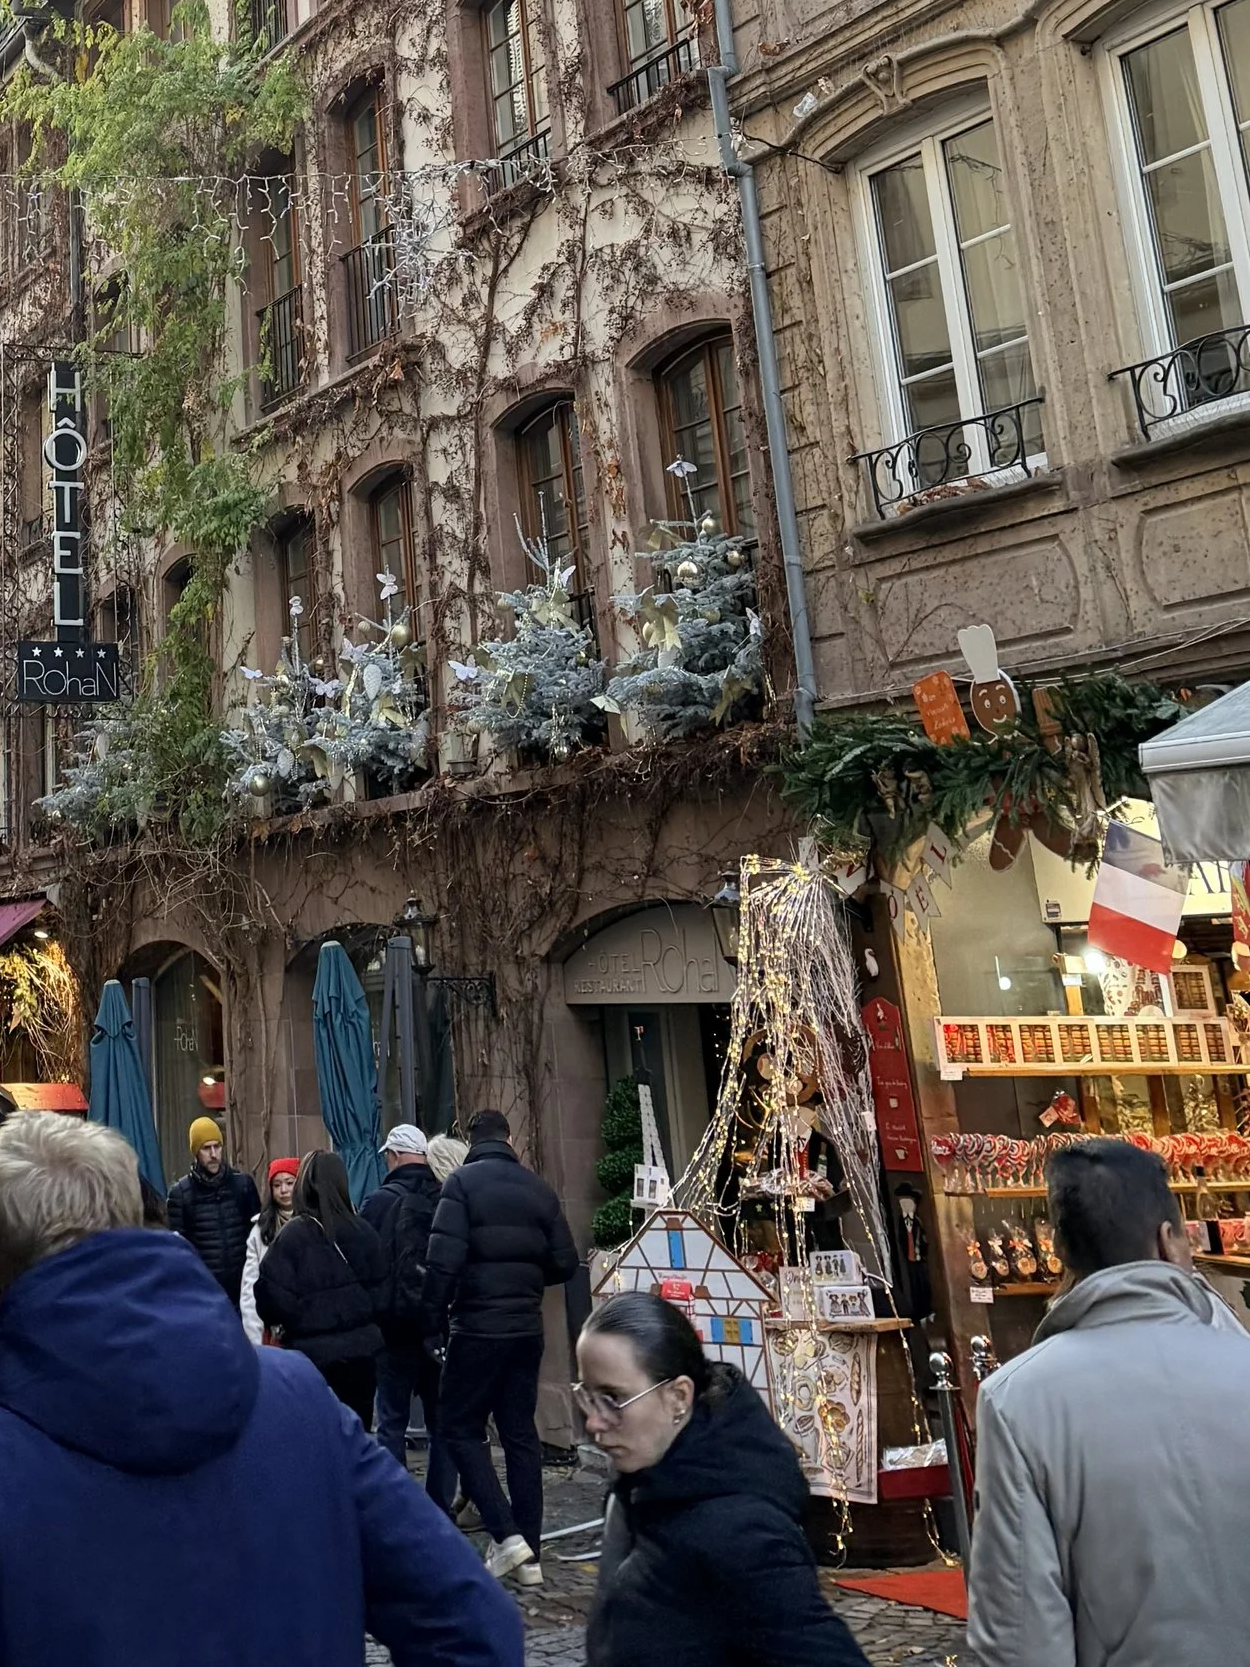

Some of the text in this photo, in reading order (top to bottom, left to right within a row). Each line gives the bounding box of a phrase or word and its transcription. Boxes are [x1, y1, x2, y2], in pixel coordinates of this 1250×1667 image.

[45, 363, 87, 626] HÔTEL
[22, 659, 117, 697] RohaN
[574, 977, 643, 995] RESTAURANT
